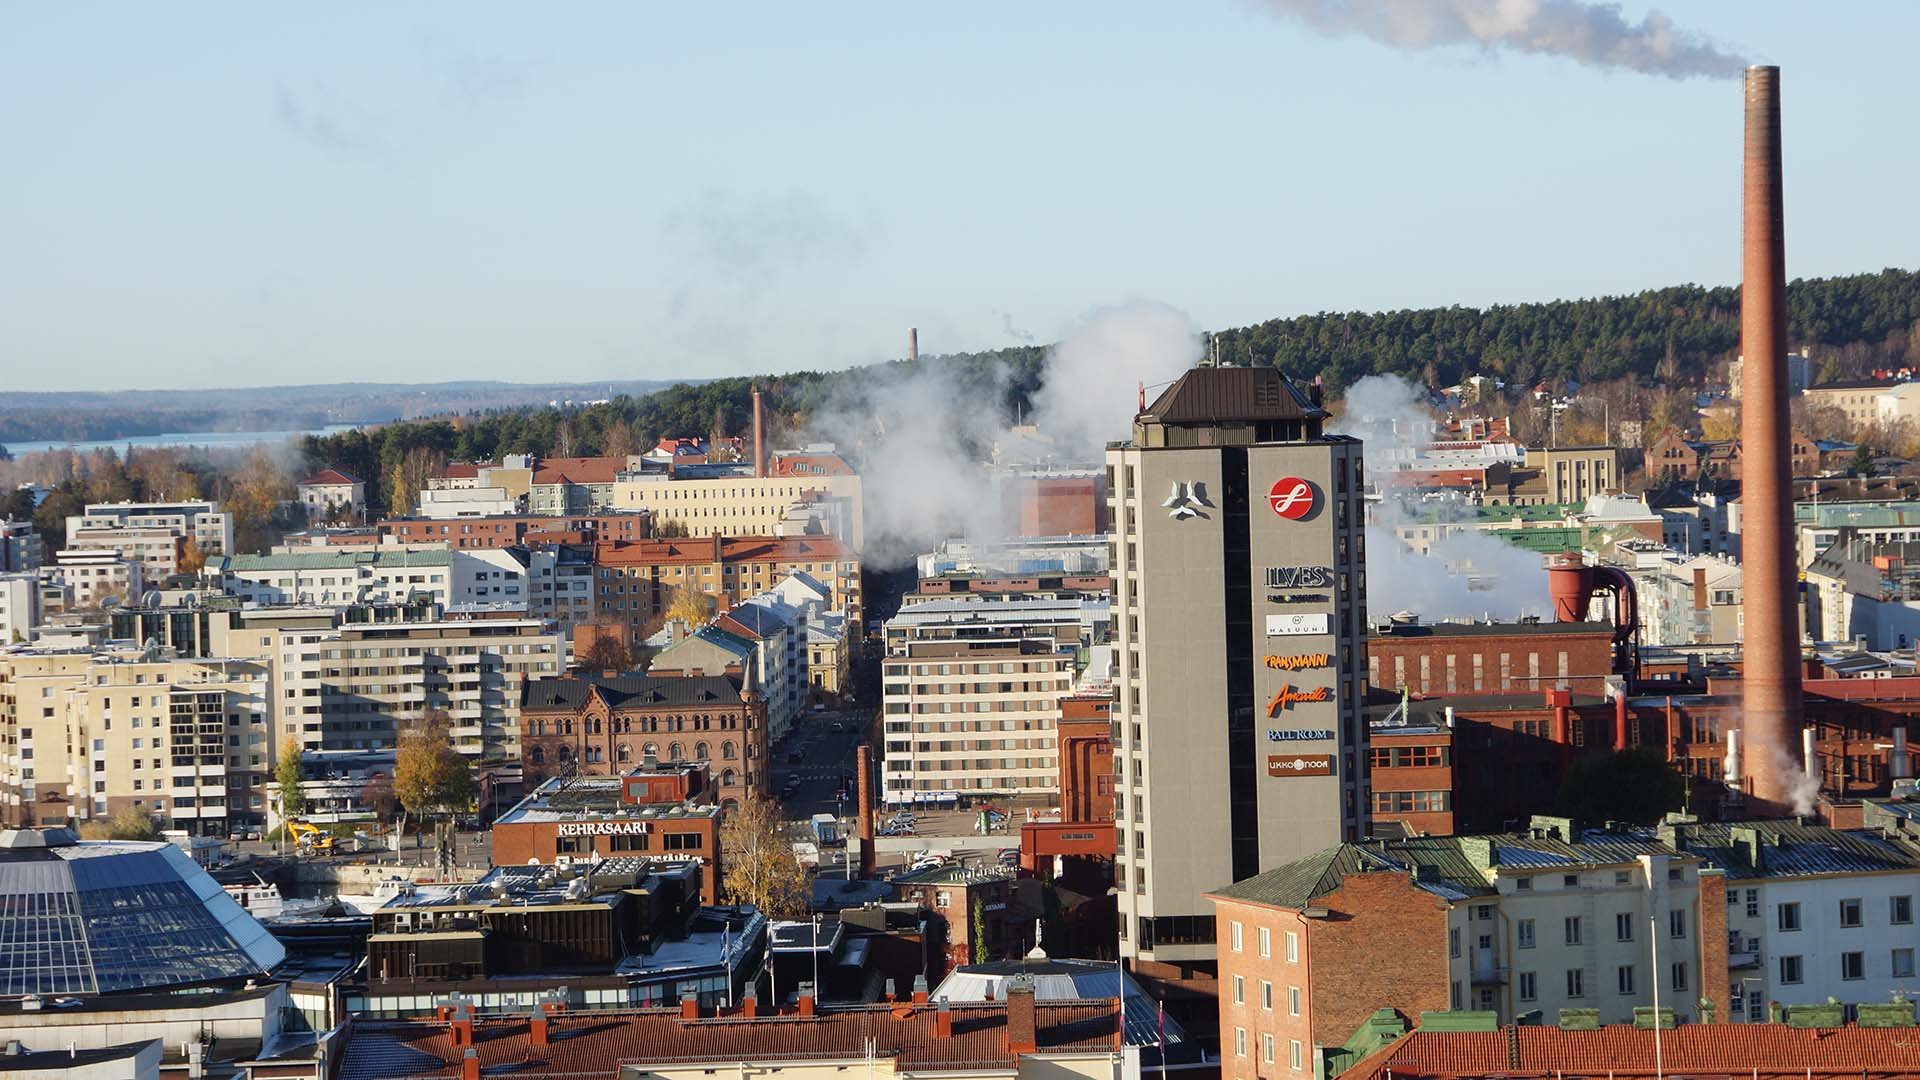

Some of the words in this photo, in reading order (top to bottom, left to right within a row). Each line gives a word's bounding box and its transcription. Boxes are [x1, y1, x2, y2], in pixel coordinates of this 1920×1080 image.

[1264, 566, 1325, 587] ILVES
[1267, 728, 1295, 740] BALL
[1296, 728, 1328, 740] ROOM
[558, 822, 647, 835] KEHRÄSAARI
